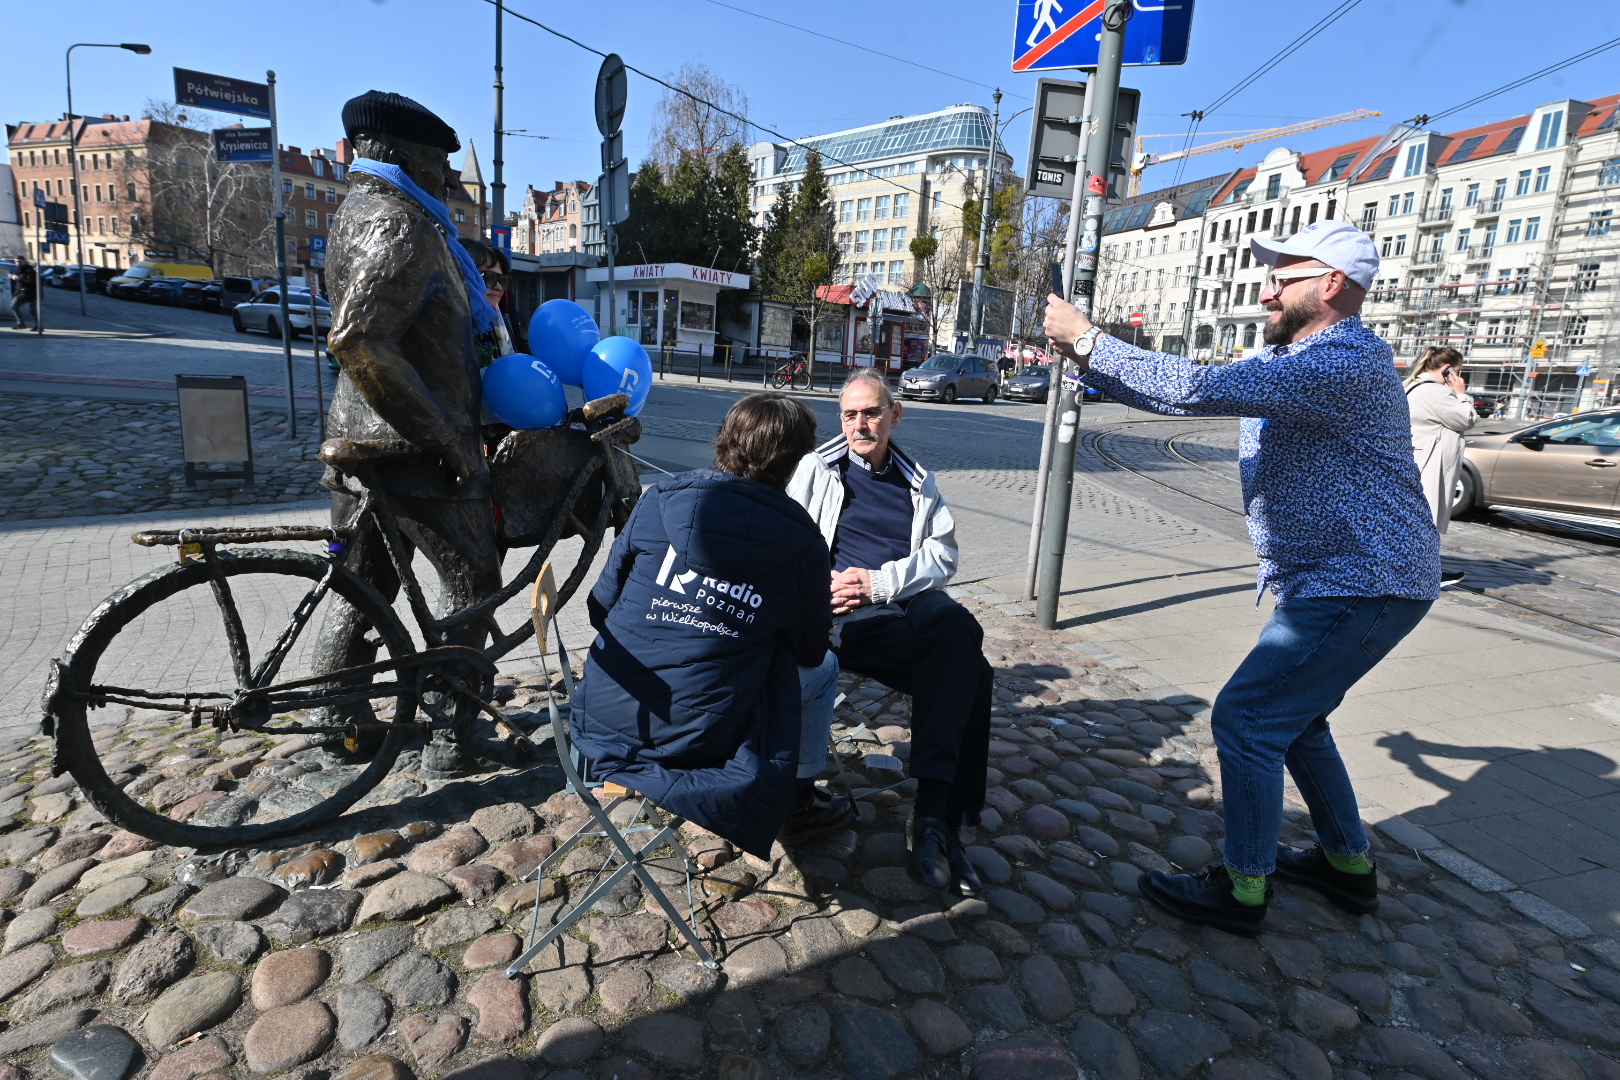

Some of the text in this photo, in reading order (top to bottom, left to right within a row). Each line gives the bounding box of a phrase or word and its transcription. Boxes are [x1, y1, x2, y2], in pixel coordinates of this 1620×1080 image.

[213, 79, 231, 87] ulica
[187, 82, 259, 106] Półwiejska
[219, 139, 268, 153] Krysiewicza
[1037, 170, 1062, 184] TONIS
[313, 238, 323, 250] P
[633, 265, 666, 278] KWIATY
[692, 267, 733, 285] KWIATY
[771, 294, 796, 304] SZKOLNE
[956, 341, 1002, 364] PAKING
[651, 597, 704, 614] pierwsze
[695, 588, 756, 624] Poznań
[646, 611, 739, 638] w Wielkopolsce
